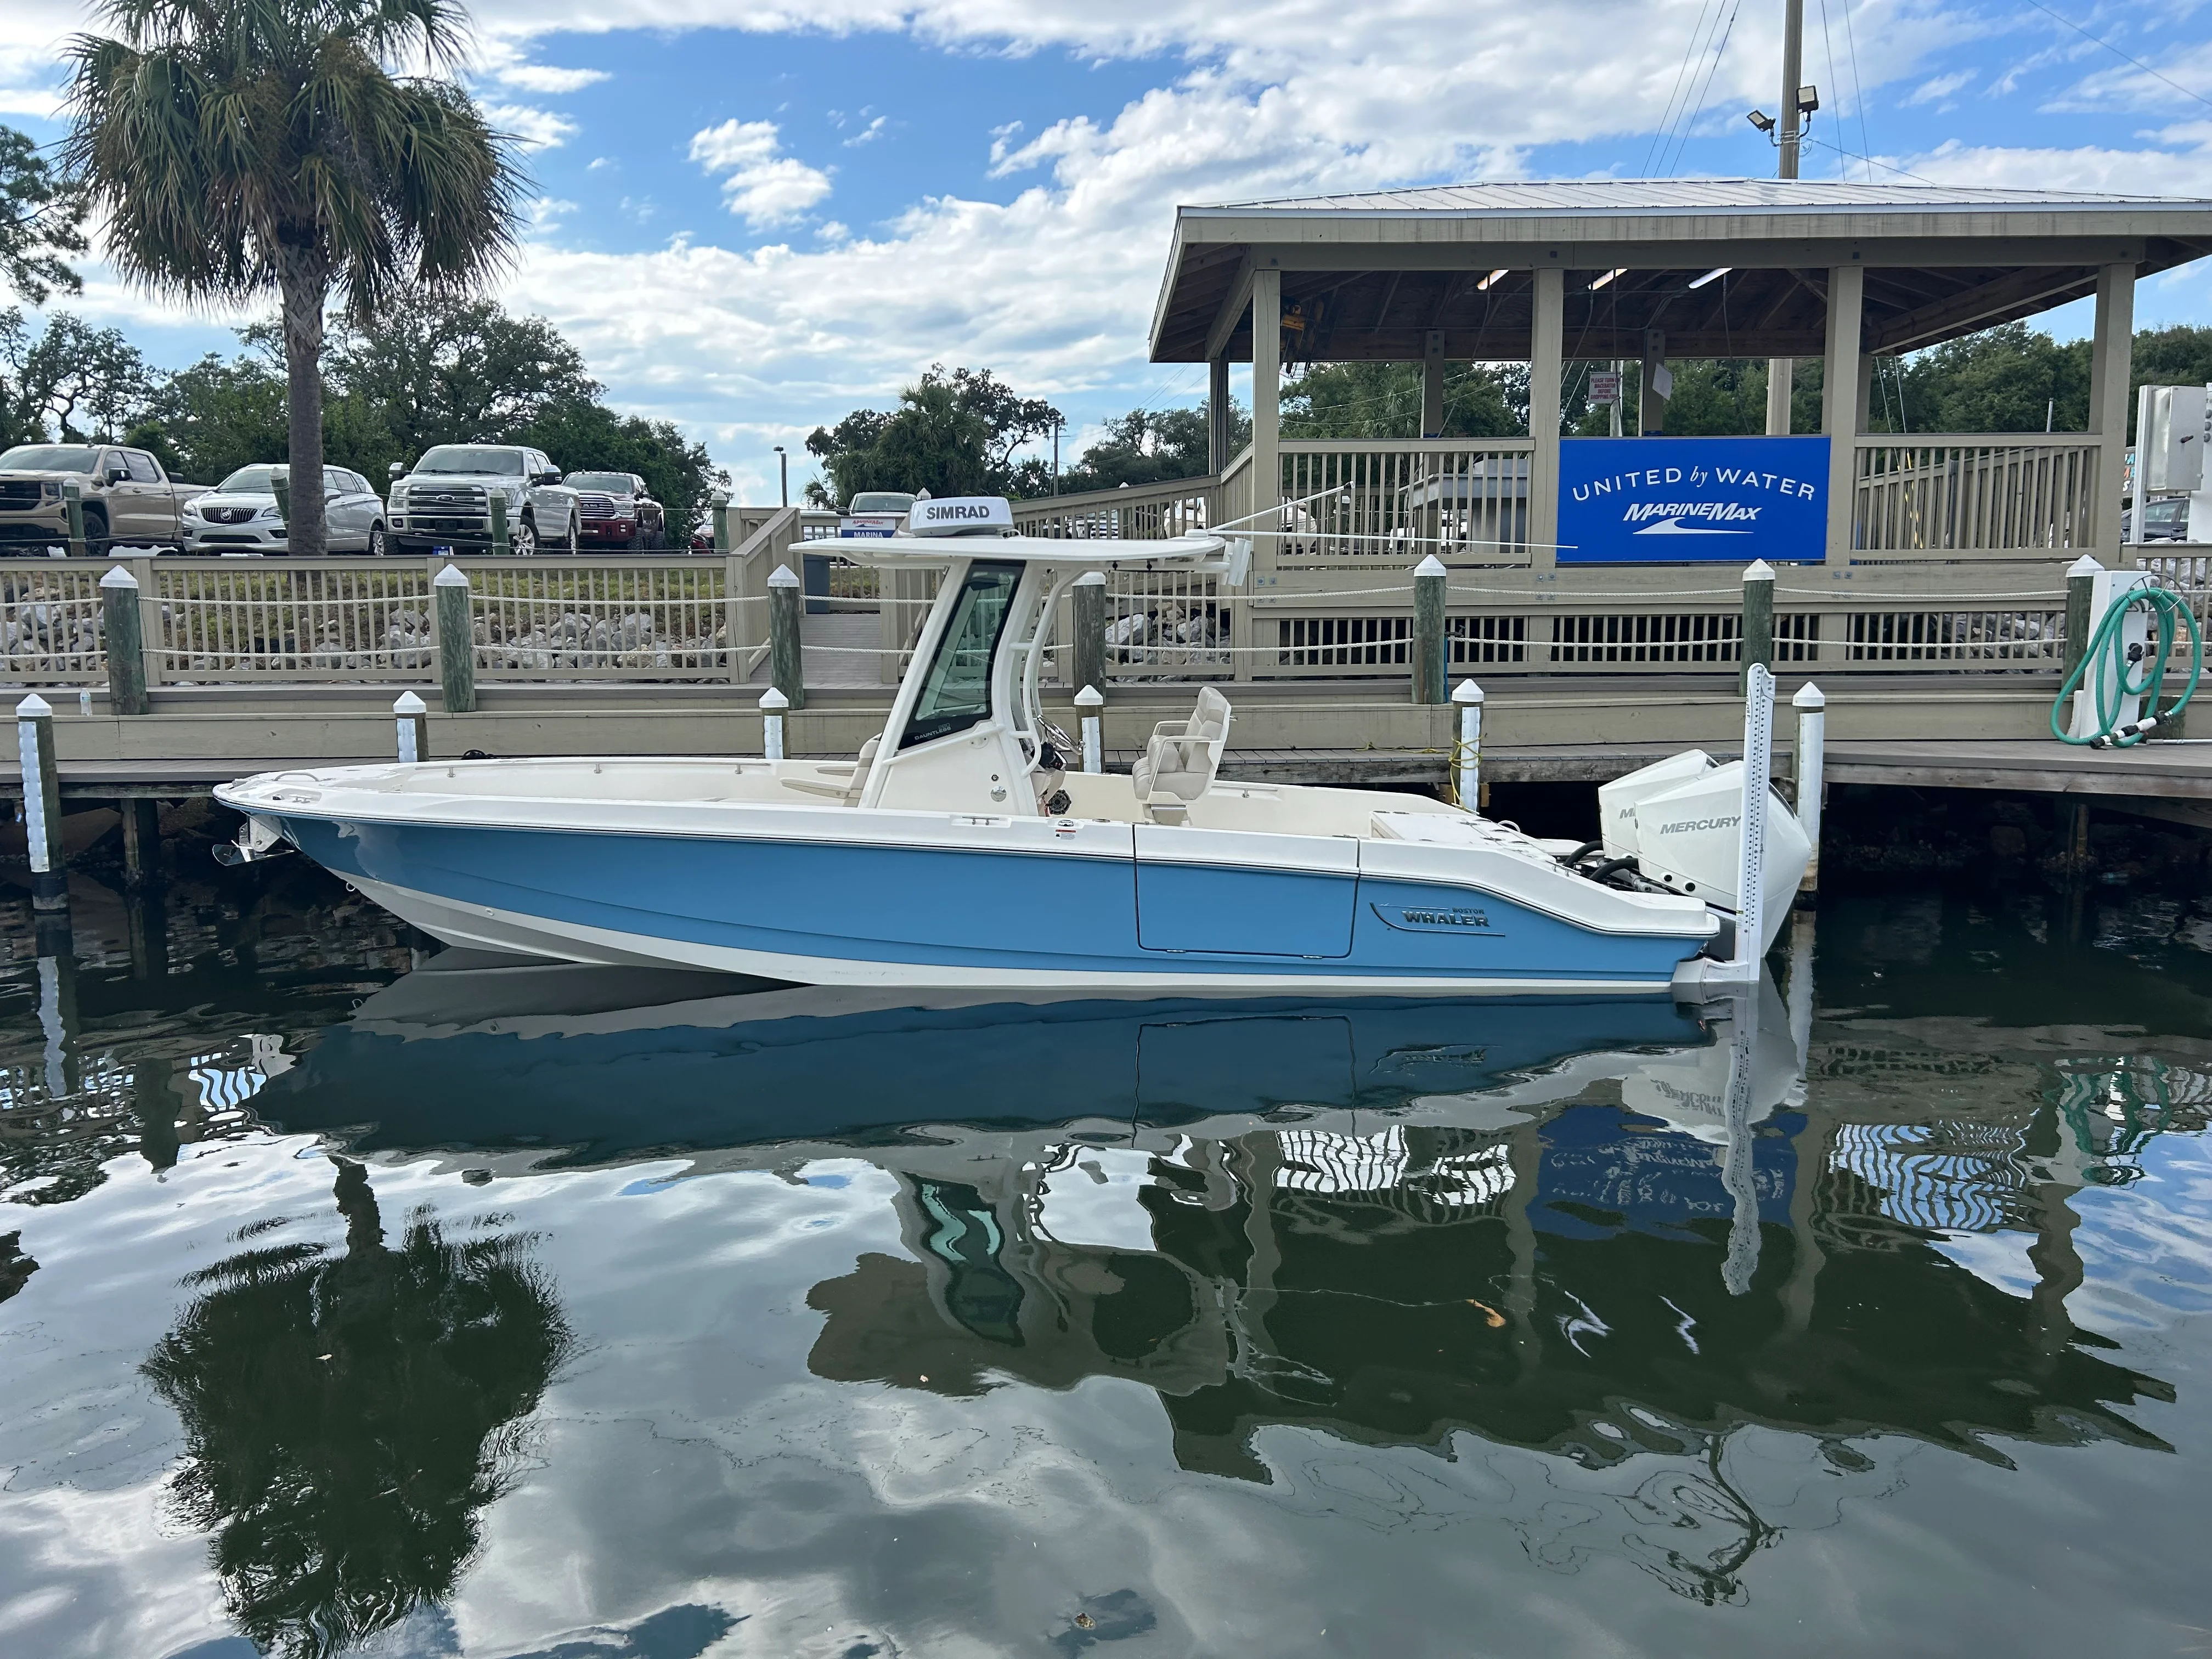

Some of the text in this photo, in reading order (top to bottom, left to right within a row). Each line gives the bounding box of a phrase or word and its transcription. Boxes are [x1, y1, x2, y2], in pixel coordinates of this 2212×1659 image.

[1572, 466, 1815, 501] UNITED by WATER
[926, 505, 990, 520] SIMRAD
[914, 726, 951, 740] DAUNTLESS
[1660, 816, 1741, 834] MERCURY
[1402, 910, 1490, 927] WHALER
